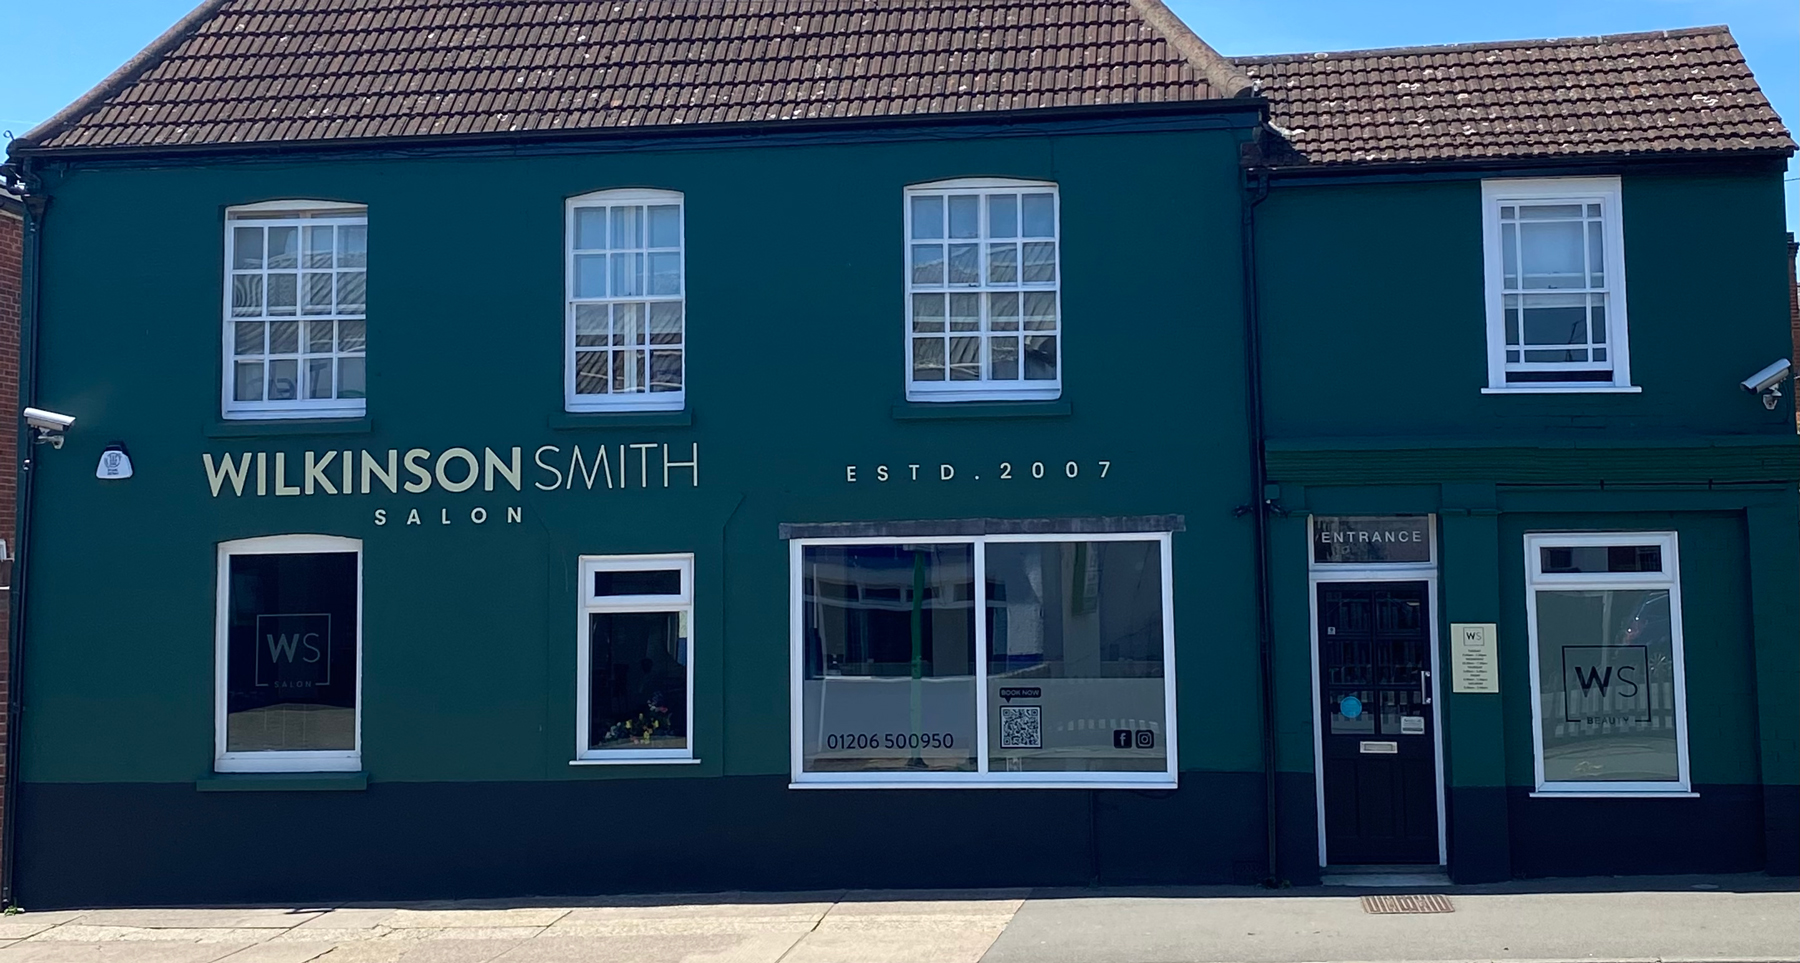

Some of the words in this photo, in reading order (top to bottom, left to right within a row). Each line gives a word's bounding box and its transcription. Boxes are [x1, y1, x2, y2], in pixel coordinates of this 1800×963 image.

[202, 446, 522, 498] WILKINSON
[534, 442, 699, 491] SMITH
[374, 506, 523, 527] SALON
[1321, 530, 1422, 543] ENTRANCE
[1466, 631, 1482, 641] WS
[266, 632, 320, 663] WS
[274, 680, 312, 688] SALON
[1574, 665, 1638, 698] WS
[1587, 716, 1630, 725] BEAUTY
[827, 733, 880, 750] 01206
[884, 732, 954, 749] 500950
